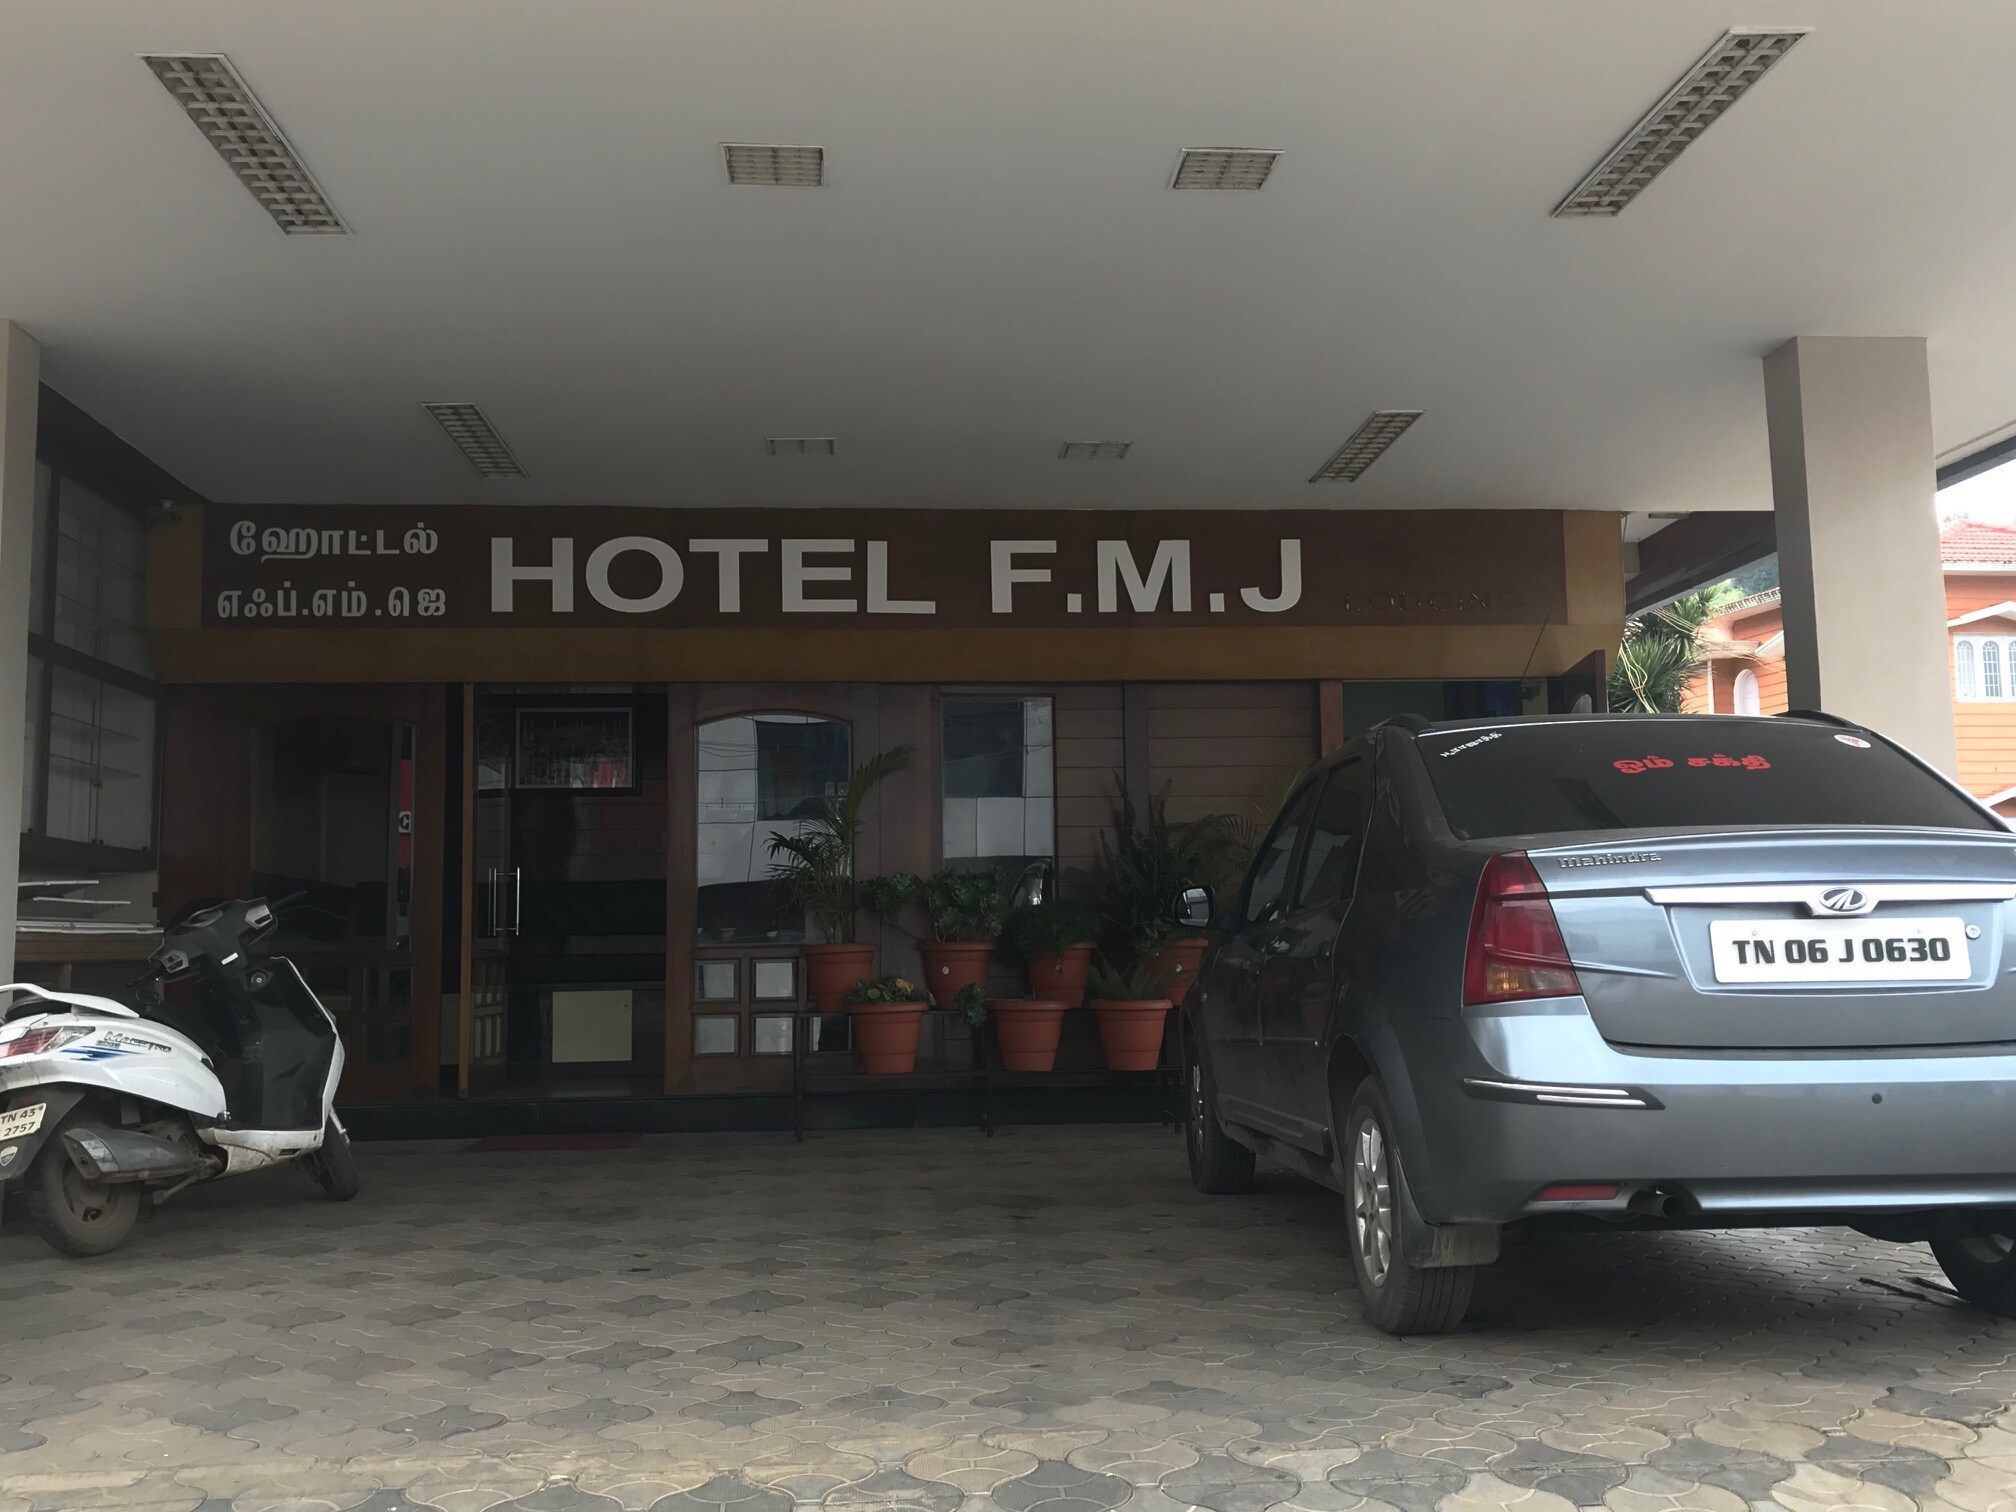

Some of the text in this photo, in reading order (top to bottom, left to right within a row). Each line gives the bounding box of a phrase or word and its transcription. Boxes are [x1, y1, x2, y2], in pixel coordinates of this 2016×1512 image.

[231, 521, 438, 562] ஹோட்டல்
[491, 537, 1302, 614] HOTEL F.M.J
[1732, 937, 1951, 964] TN 06 J 0630
[1, 1108, 36, 1124] TN 43
[3, 1121, 36, 1137] 2757
